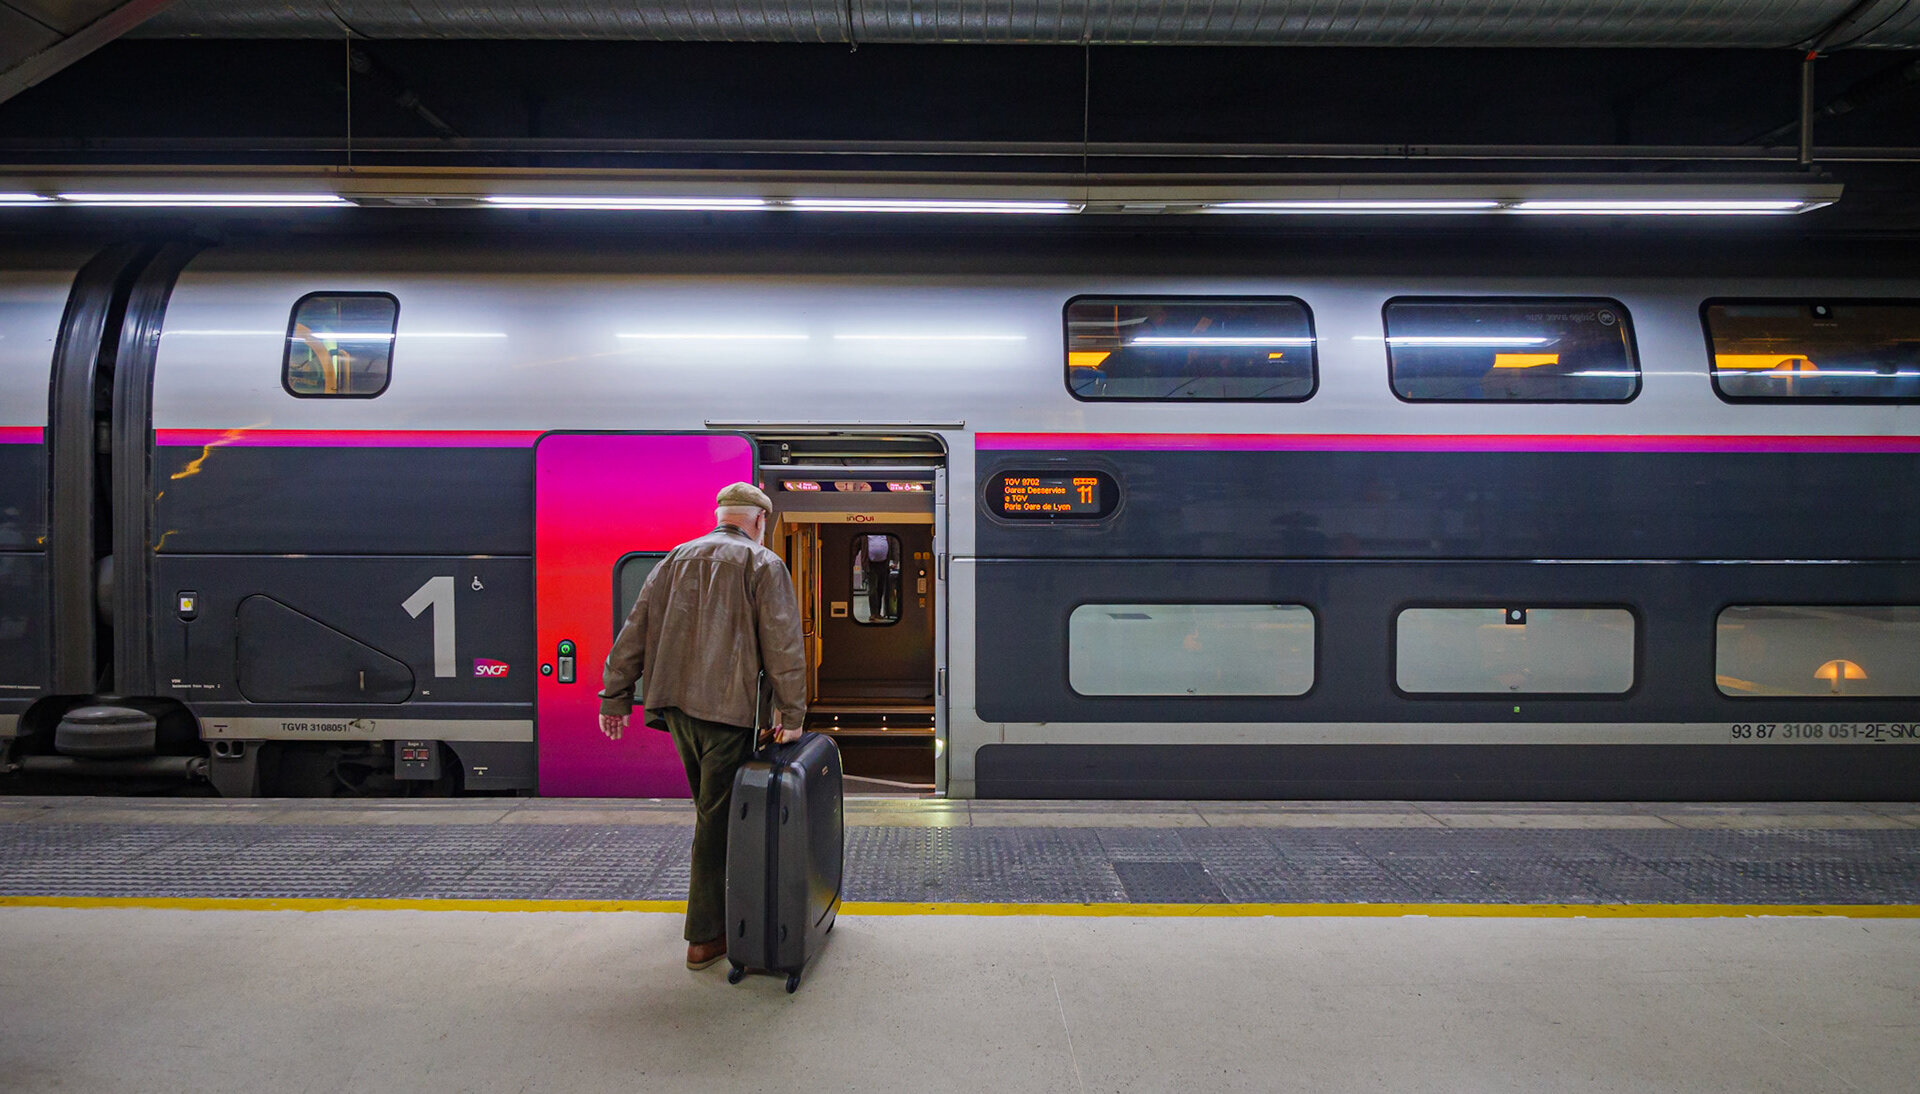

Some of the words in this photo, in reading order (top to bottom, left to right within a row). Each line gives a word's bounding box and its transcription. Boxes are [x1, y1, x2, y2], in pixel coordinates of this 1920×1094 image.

[1004, 478, 1020, 486] TGV
[1004, 486, 1026, 494] Gares
[1027, 486, 1066, 495] Desservies
[1076, 485, 1093, 504] 11
[1012, 494, 1028, 502] TGV
[1004, 502, 1022, 511] Paris
[1023, 502, 1041, 511] Gare
[1042, 502, 1052, 511] de
[1053, 503, 1071, 511] Lyon
[401, 576, 456, 677] 1
[475, 665, 508, 676] SNCF
[281, 722, 308, 731] TGVR
[310, 723, 347, 732] 3108051
[1731, 723, 1752, 739] 93
[1756, 723, 1777, 739] 87
[1782, 723, 1824, 739] 3108
